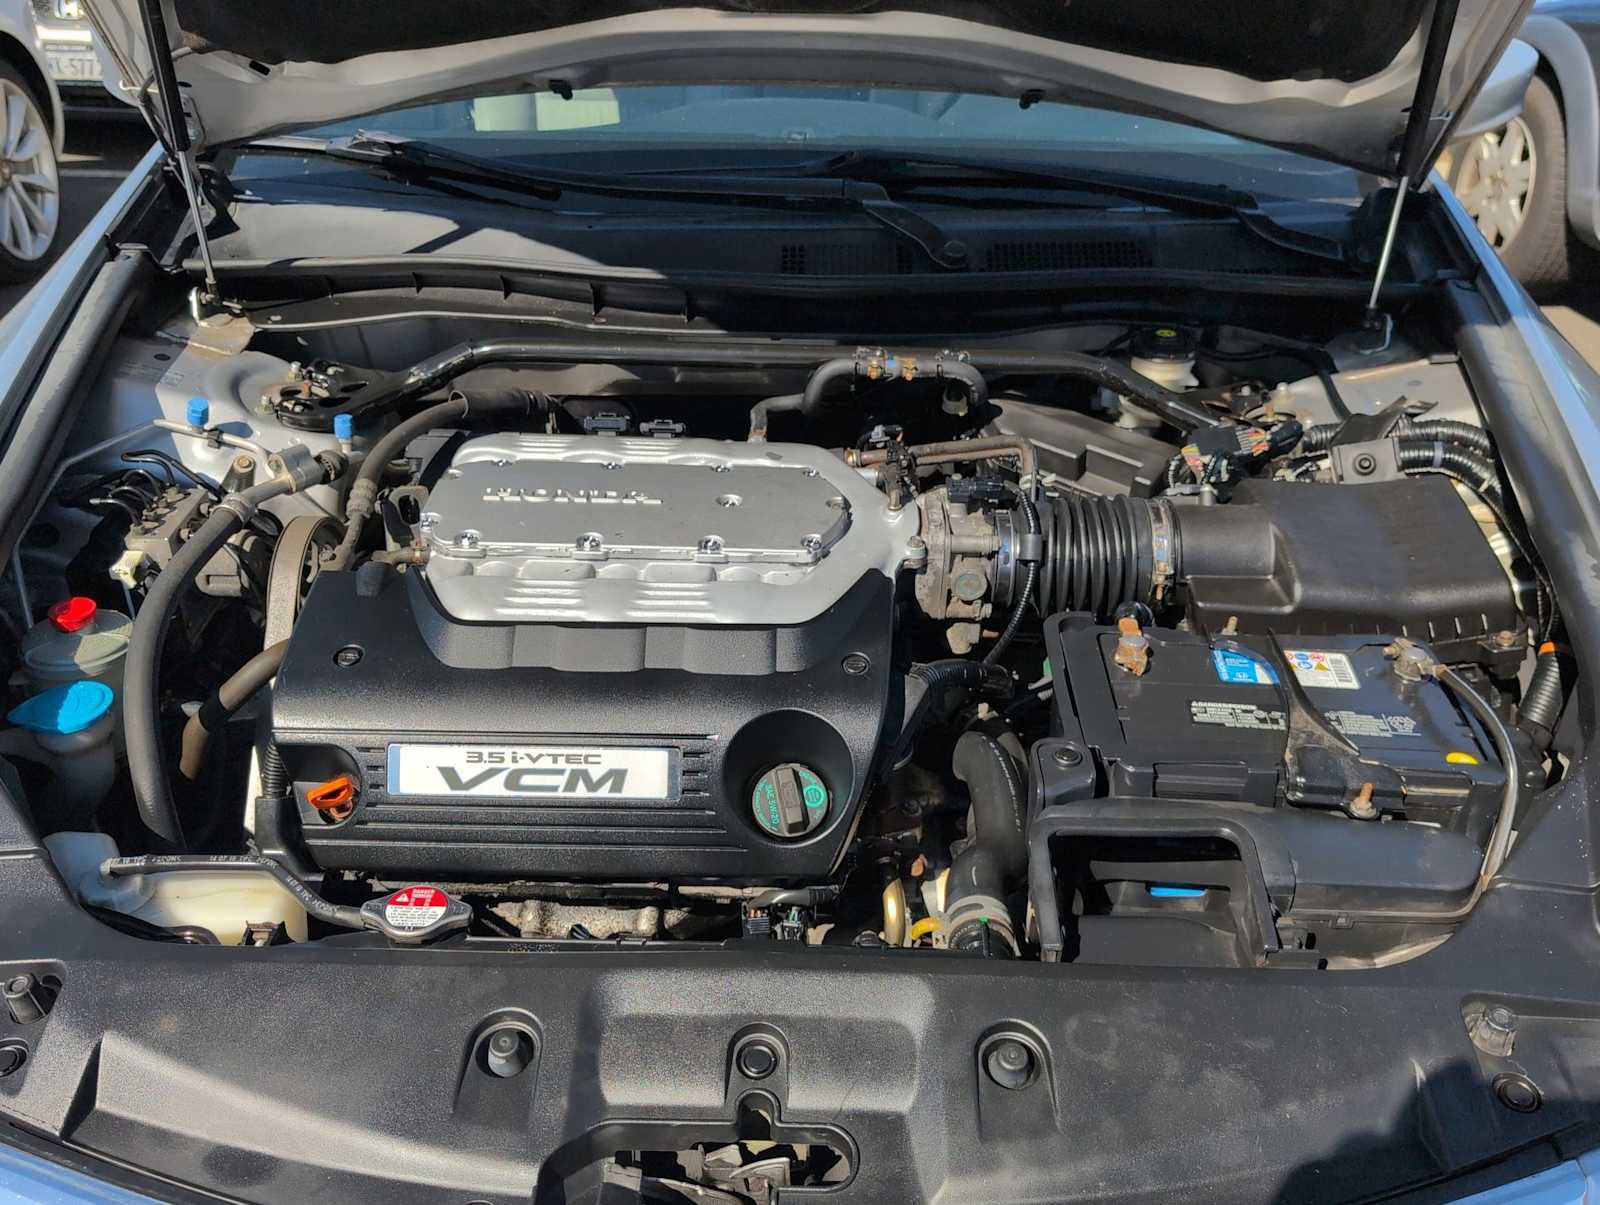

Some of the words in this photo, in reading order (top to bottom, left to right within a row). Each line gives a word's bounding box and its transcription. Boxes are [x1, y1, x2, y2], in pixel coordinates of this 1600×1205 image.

[483, 487, 663, 505] HONDA
[466, 751, 505, 764] 3.5
[511, 752, 602, 765] i-VTEC
[437, 766, 629, 794] VCM
